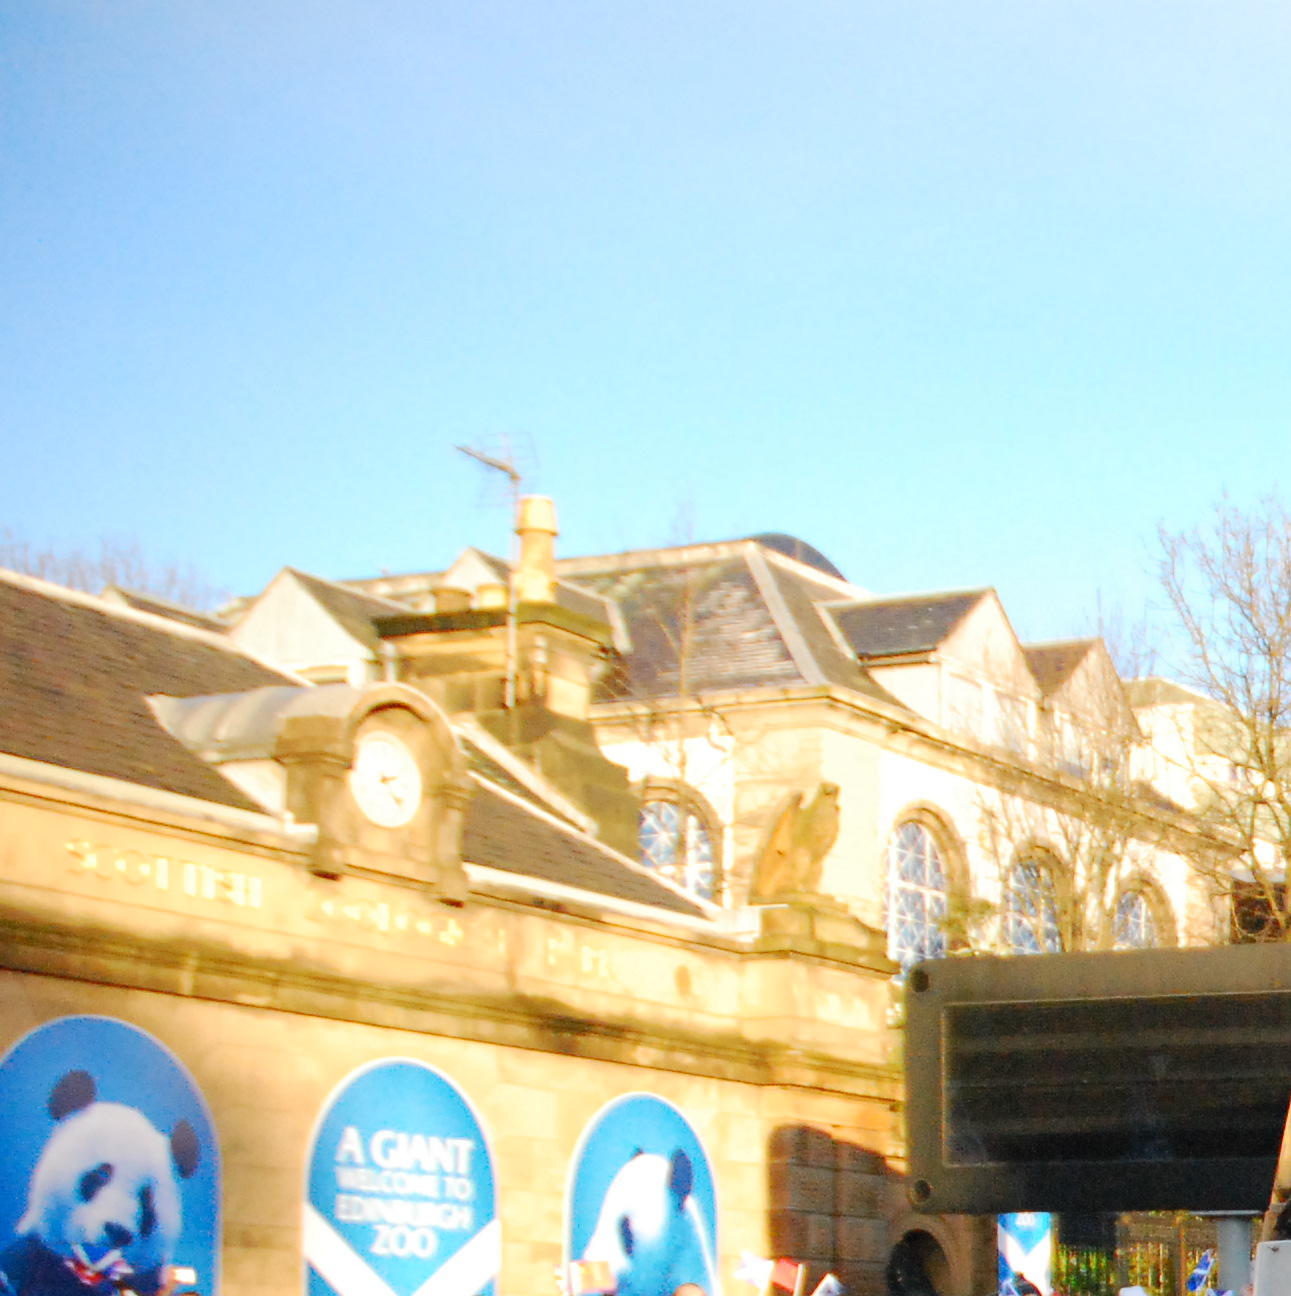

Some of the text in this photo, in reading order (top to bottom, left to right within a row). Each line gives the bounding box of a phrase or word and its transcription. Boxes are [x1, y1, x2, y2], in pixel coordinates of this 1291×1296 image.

[335, 1126, 476, 1175] A GIANT
[335, 1165, 476, 1201] WELCOME TO
[335, 1193, 475, 1233] EDINBURGH
[369, 1223, 439, 1259] ZOO
